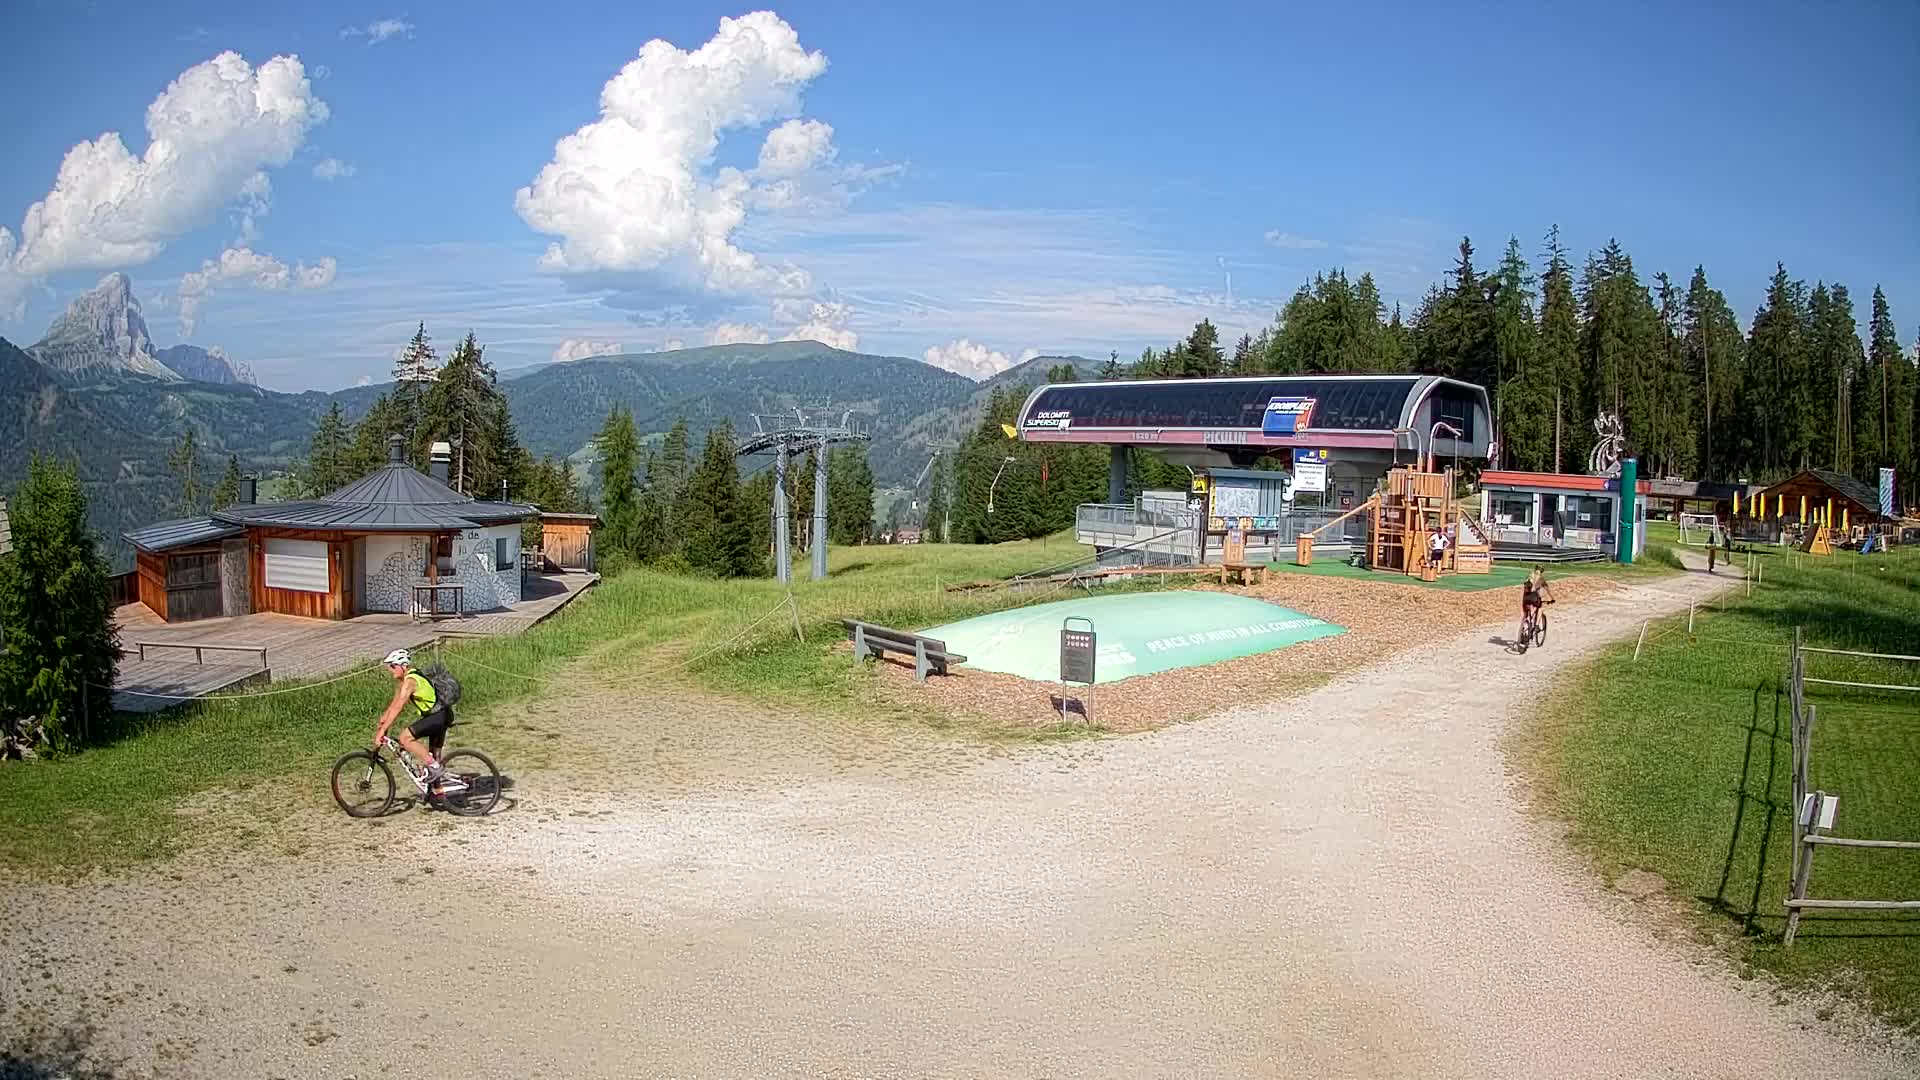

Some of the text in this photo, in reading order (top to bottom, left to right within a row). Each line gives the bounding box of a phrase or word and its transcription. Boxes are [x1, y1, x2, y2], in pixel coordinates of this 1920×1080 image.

[1037, 411, 1070, 419] DOLOMITI
[1203, 432, 1248, 444] PICULIN
[1147, 636, 1188, 652] PEACE
